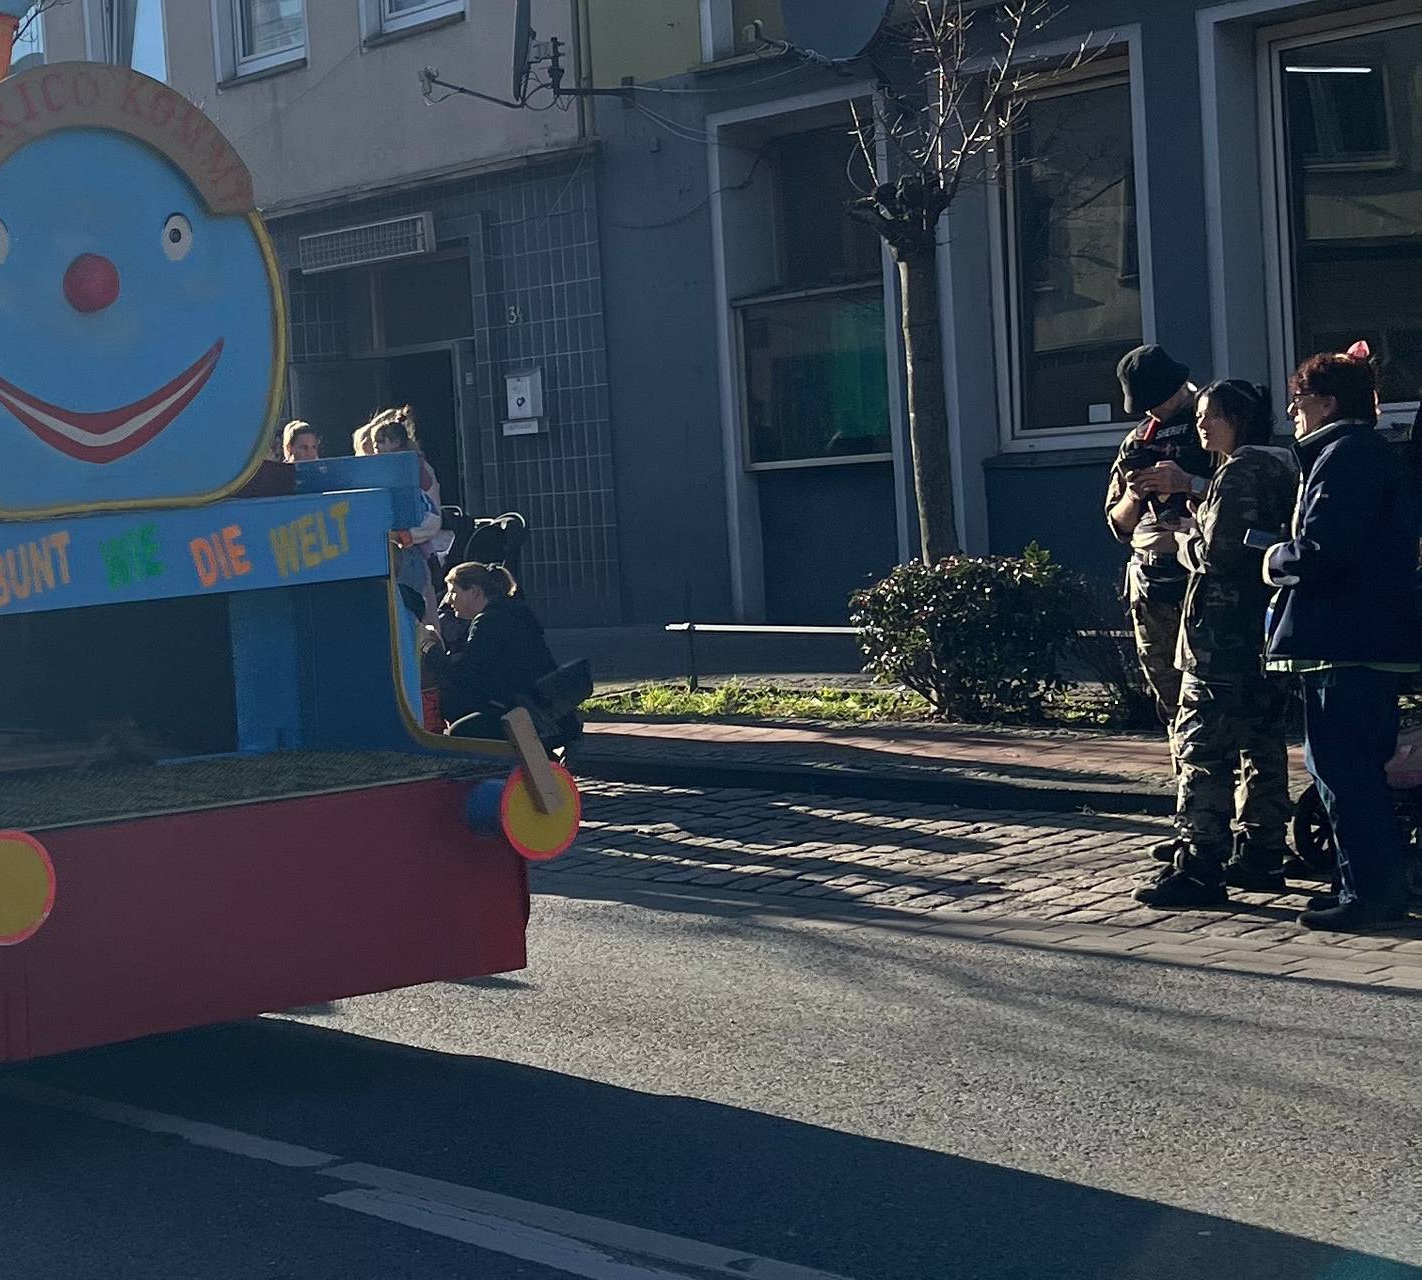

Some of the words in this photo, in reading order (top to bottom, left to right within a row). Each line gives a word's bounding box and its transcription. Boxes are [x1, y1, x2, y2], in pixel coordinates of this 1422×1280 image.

[1155, 423, 1188, 440] SHERIFF
[99, 523, 166, 592] WIE
[189, 524, 251, 588] DIE
[269, 501, 350, 578] WELT
